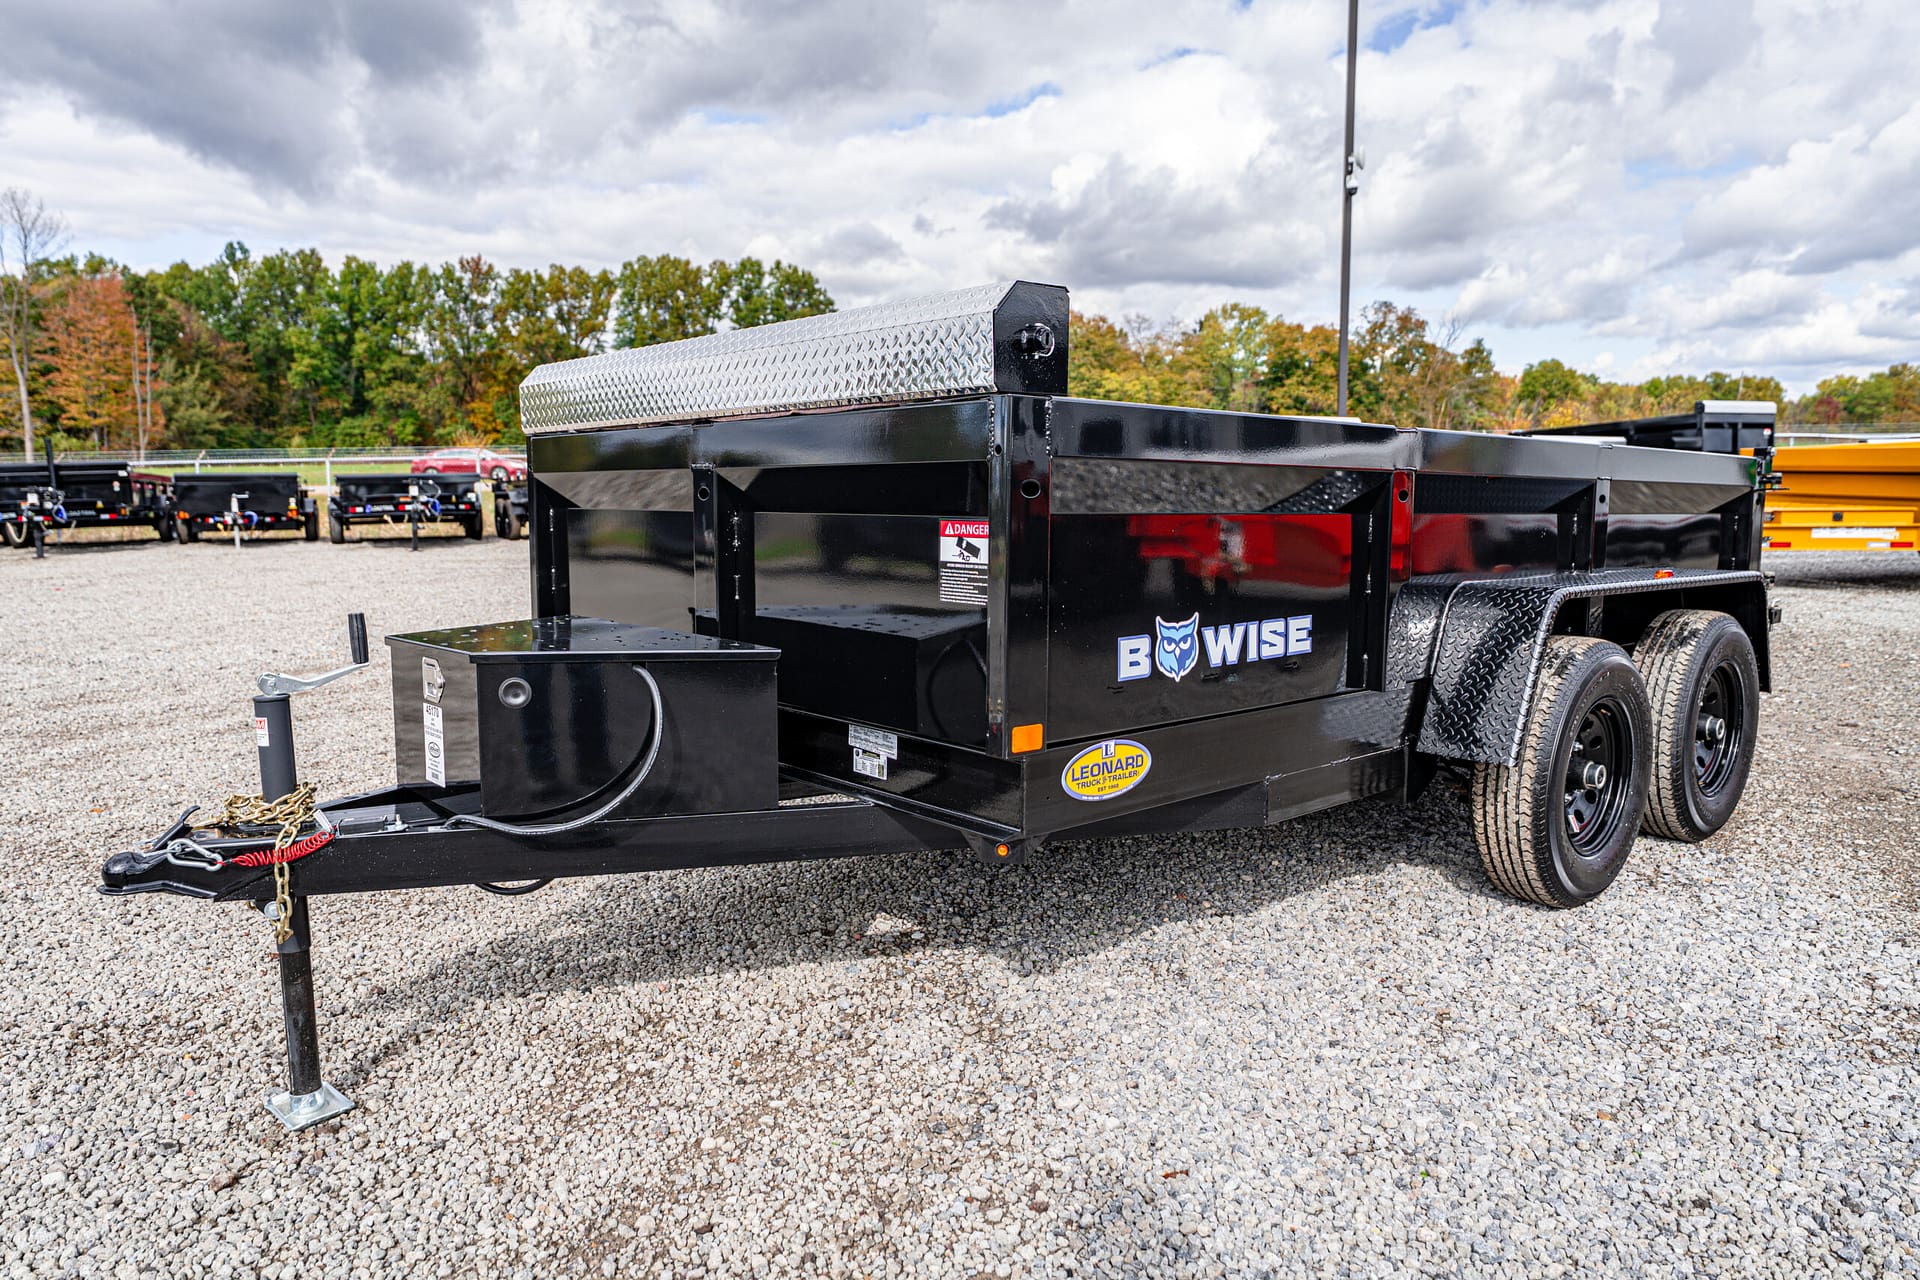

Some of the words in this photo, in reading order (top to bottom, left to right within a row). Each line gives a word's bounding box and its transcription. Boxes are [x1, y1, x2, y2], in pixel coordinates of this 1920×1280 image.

[954, 523, 989, 535] DANGER
[1071, 753, 1144, 782] LEONARD
[1076, 778, 1101, 790] TRUCK
[1108, 770, 1138, 782] TRAILER
